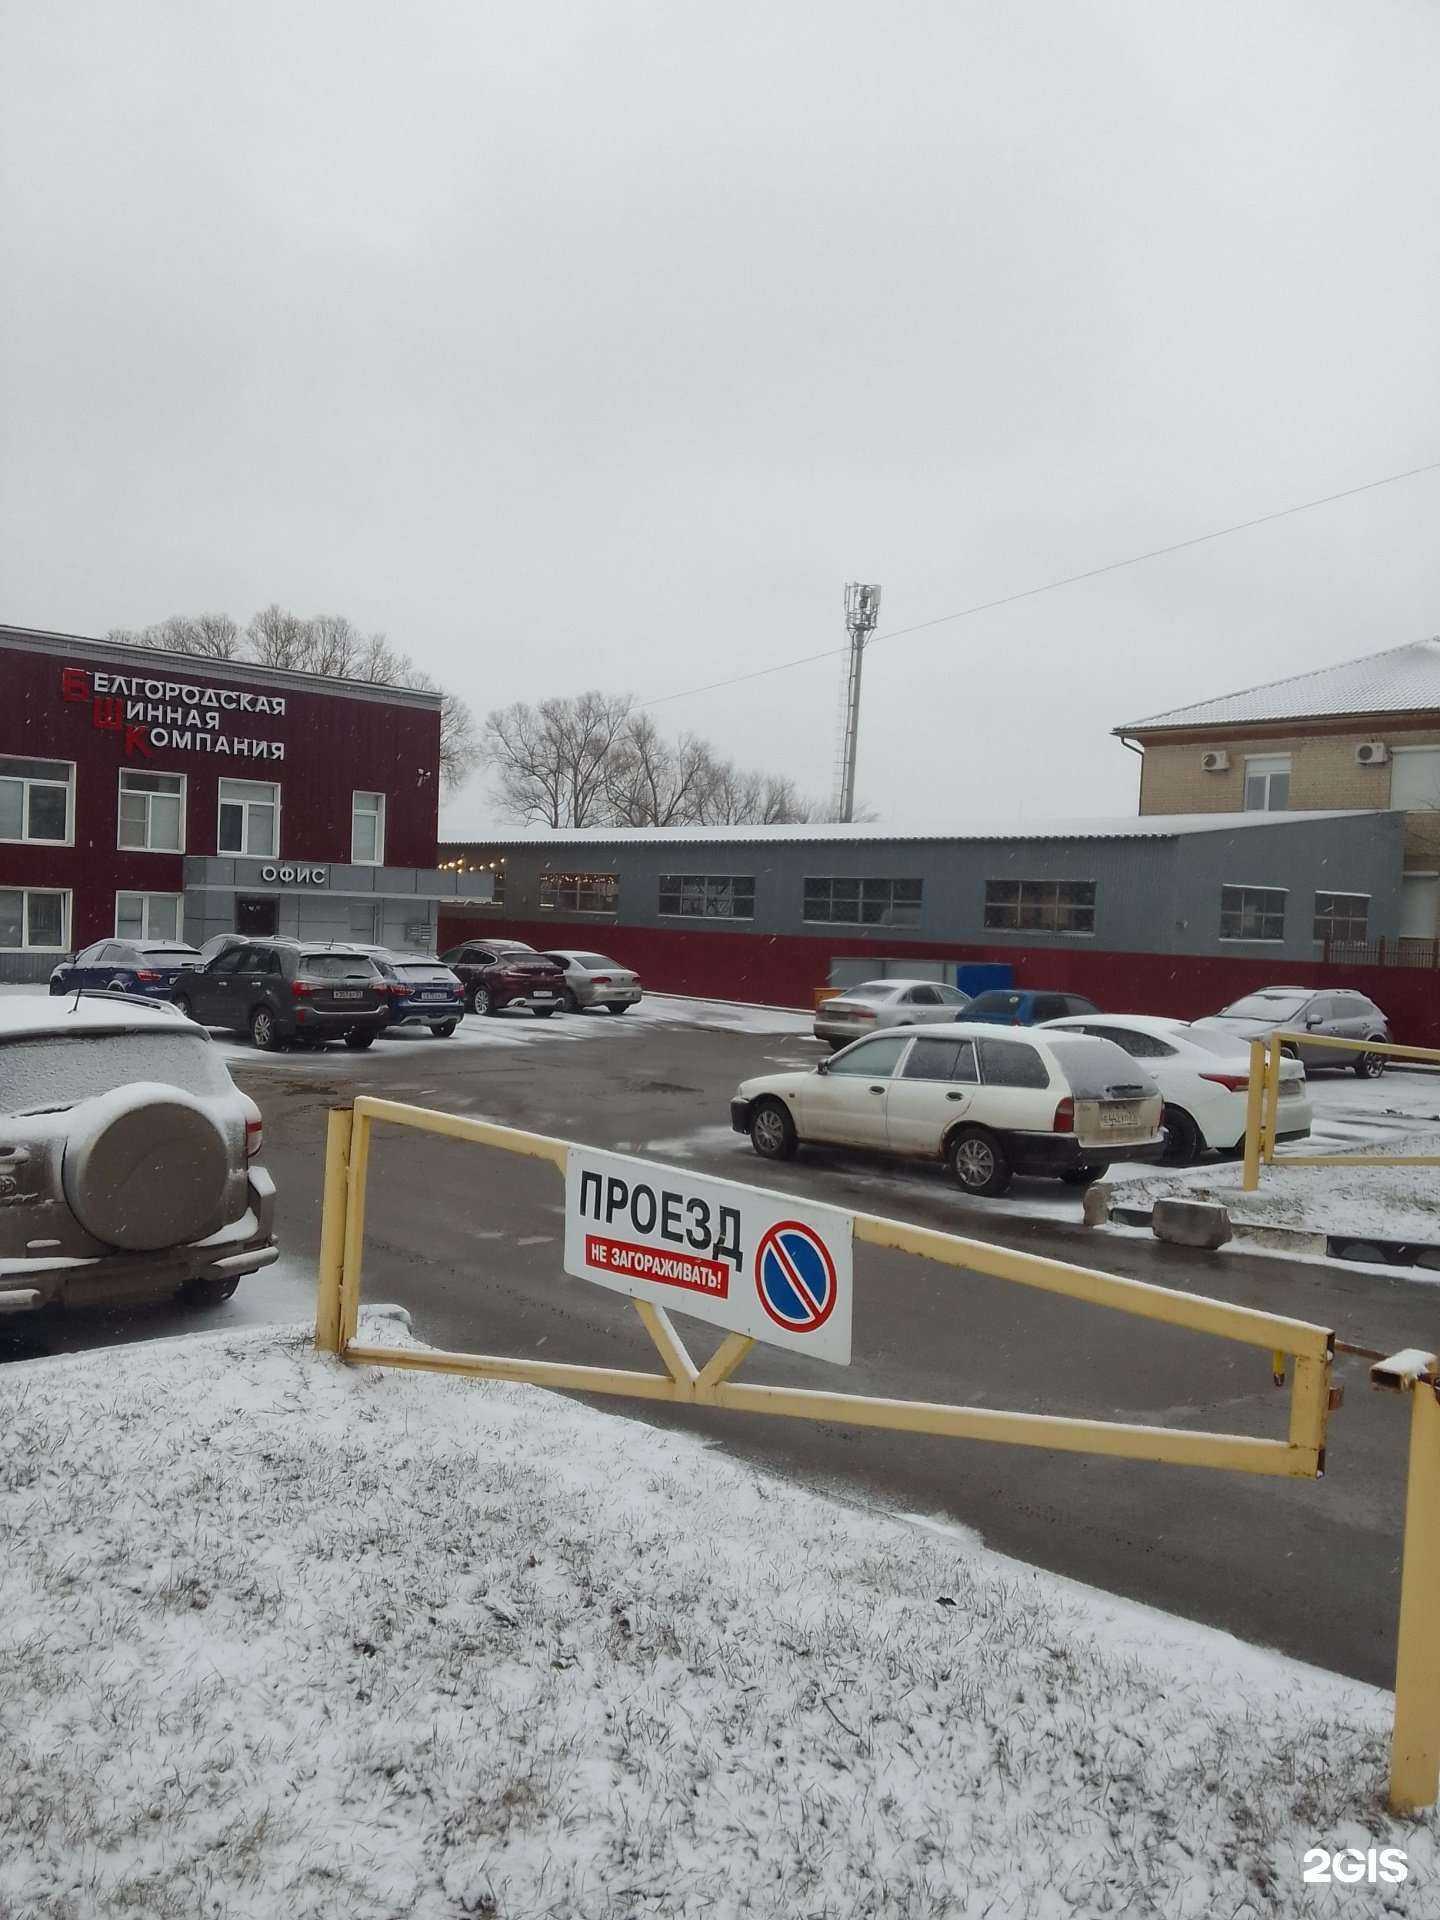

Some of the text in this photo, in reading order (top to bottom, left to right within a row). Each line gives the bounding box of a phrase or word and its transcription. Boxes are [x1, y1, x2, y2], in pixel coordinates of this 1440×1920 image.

[63, 667, 286, 716] БЕЛГОРОДСКАЯ
[94, 696, 220, 730] ШИННАЯ
[125, 724, 285, 761] КОМПАНИЯ
[262, 865, 326, 883] ОФИС
[579, 1169, 743, 1272] ПРОЕЗД
[591, 1243, 722, 1290] НЕ ЗАГОРАЖИВАТЬ!
